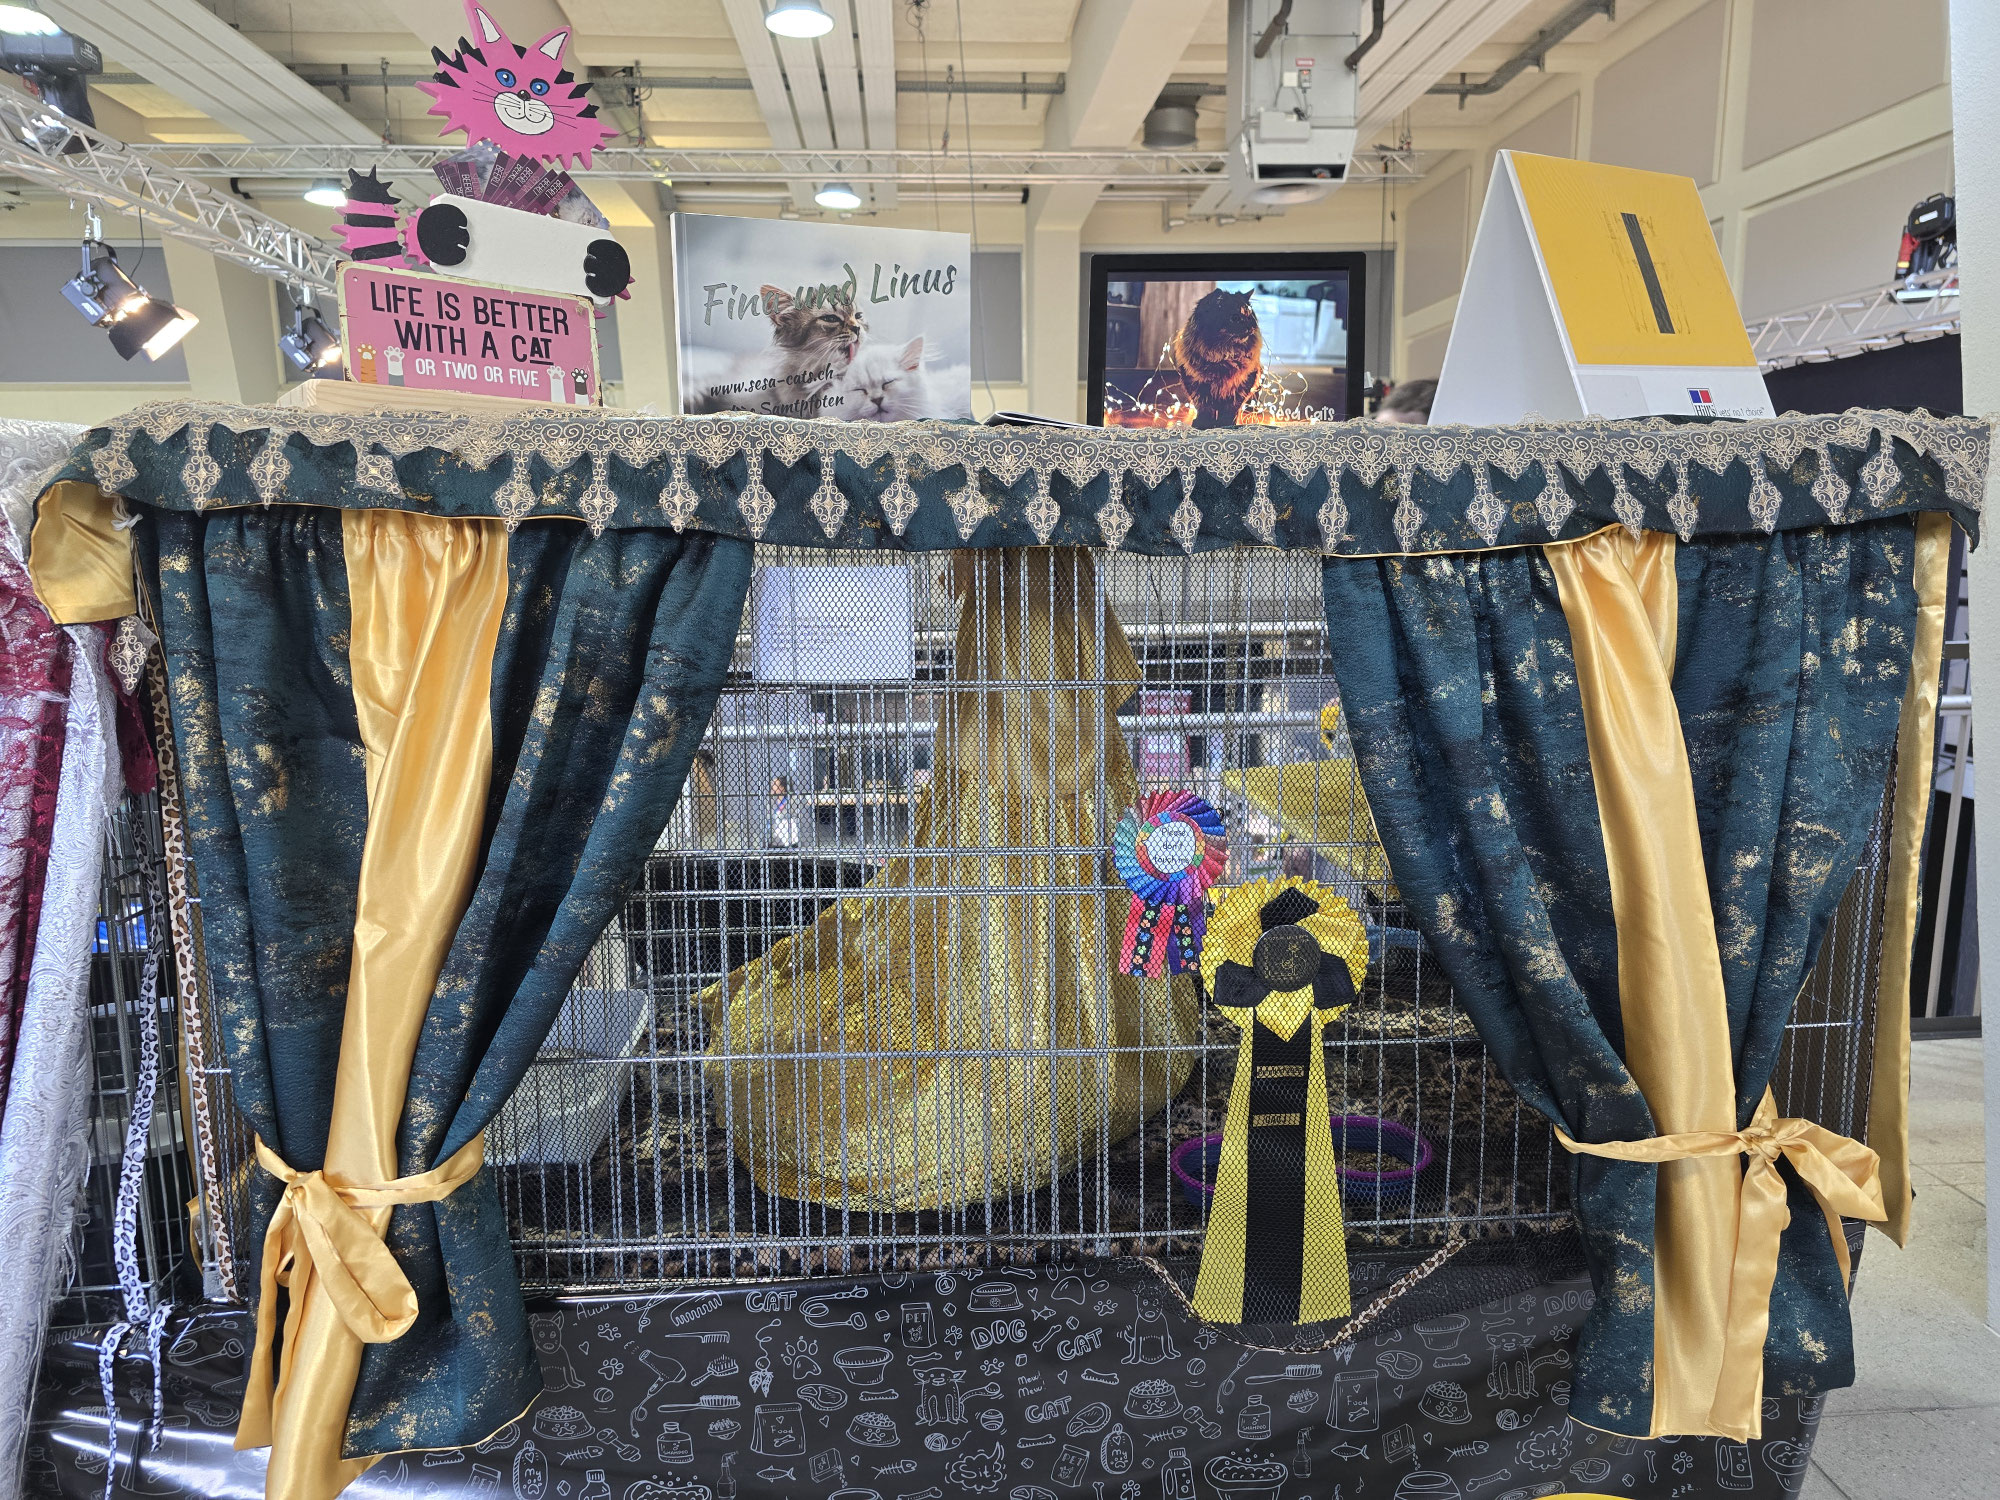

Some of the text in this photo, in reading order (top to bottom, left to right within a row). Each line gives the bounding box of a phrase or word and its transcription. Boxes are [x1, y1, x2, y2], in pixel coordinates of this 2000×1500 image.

[515, 167, 533, 187] BEERLI
[545, 179, 564, 199] BEERLI
[703, 262, 957, 326] Fina und Linus
[370, 281, 570, 336] LIFE IS BETTER
[394, 319, 555, 365] WITH A CAT
[415, 358, 540, 388] OR TWO OR FIVE
[710, 363, 834, 398] www.sesa-cats.ch
[1269, 404, 1335, 421] Sesa Cats
[1162, 827, 1186, 836] Please
[746, 1290, 798, 1313] CAT
[1543, 1290, 1597, 1316] DOG
[905, 1312, 928, 1324] PET
[970, 1318, 1028, 1350] DOG
[1056, 1327, 1103, 1361] CAT
[1025, 1395, 1072, 1423] CAT
[1347, 1395, 1369, 1406] Food
[771, 1425, 793, 1435] Food
[1062, 1453, 1086, 1467] PET
[959, 1463, 997, 1479] Sit!
[471, 1475, 496, 1493] PET
